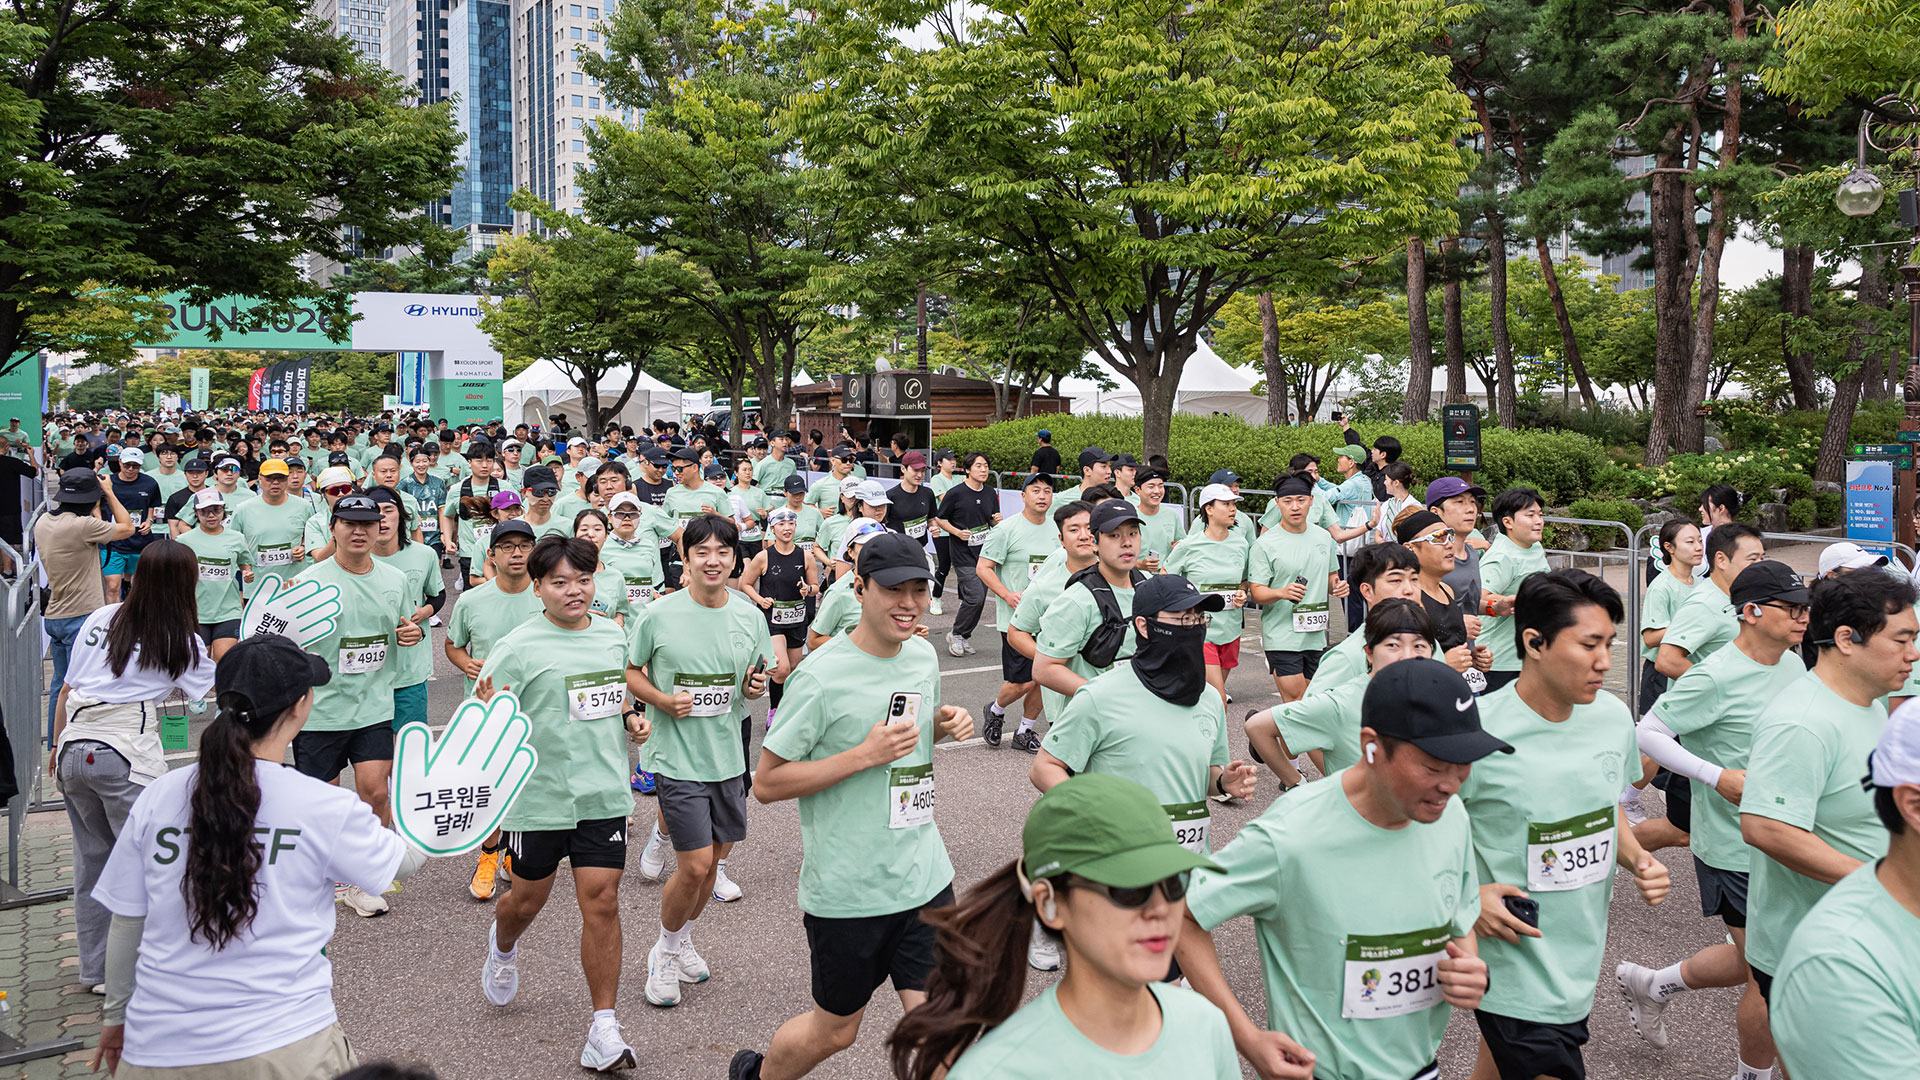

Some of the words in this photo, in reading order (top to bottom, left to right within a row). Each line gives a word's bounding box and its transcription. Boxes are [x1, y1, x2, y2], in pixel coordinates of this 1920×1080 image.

[155, 304, 238, 332] RUN
[432, 306, 484, 317] HYUNDA
[900, 402, 917, 410] olleh
[917, 400, 927, 410] kt
[268, 552, 290, 561] 5191
[207, 568, 229, 576] 4991
[629, 588, 651, 598] 3958
[784, 610, 804, 619] 5209
[1306, 614, 1327, 625] 5303
[263, 612, 289, 633] 함께
[357, 650, 385, 664] 4919
[591, 690, 623, 708] 5745
[693, 692, 730, 706] 5603
[414, 785, 492, 812] 그루원들
[434, 811, 475, 837] 달려!
[1176, 826, 1204, 845] 821
[1562, 840, 1610, 872] 3817
[1387, 966, 1442, 996] 381
